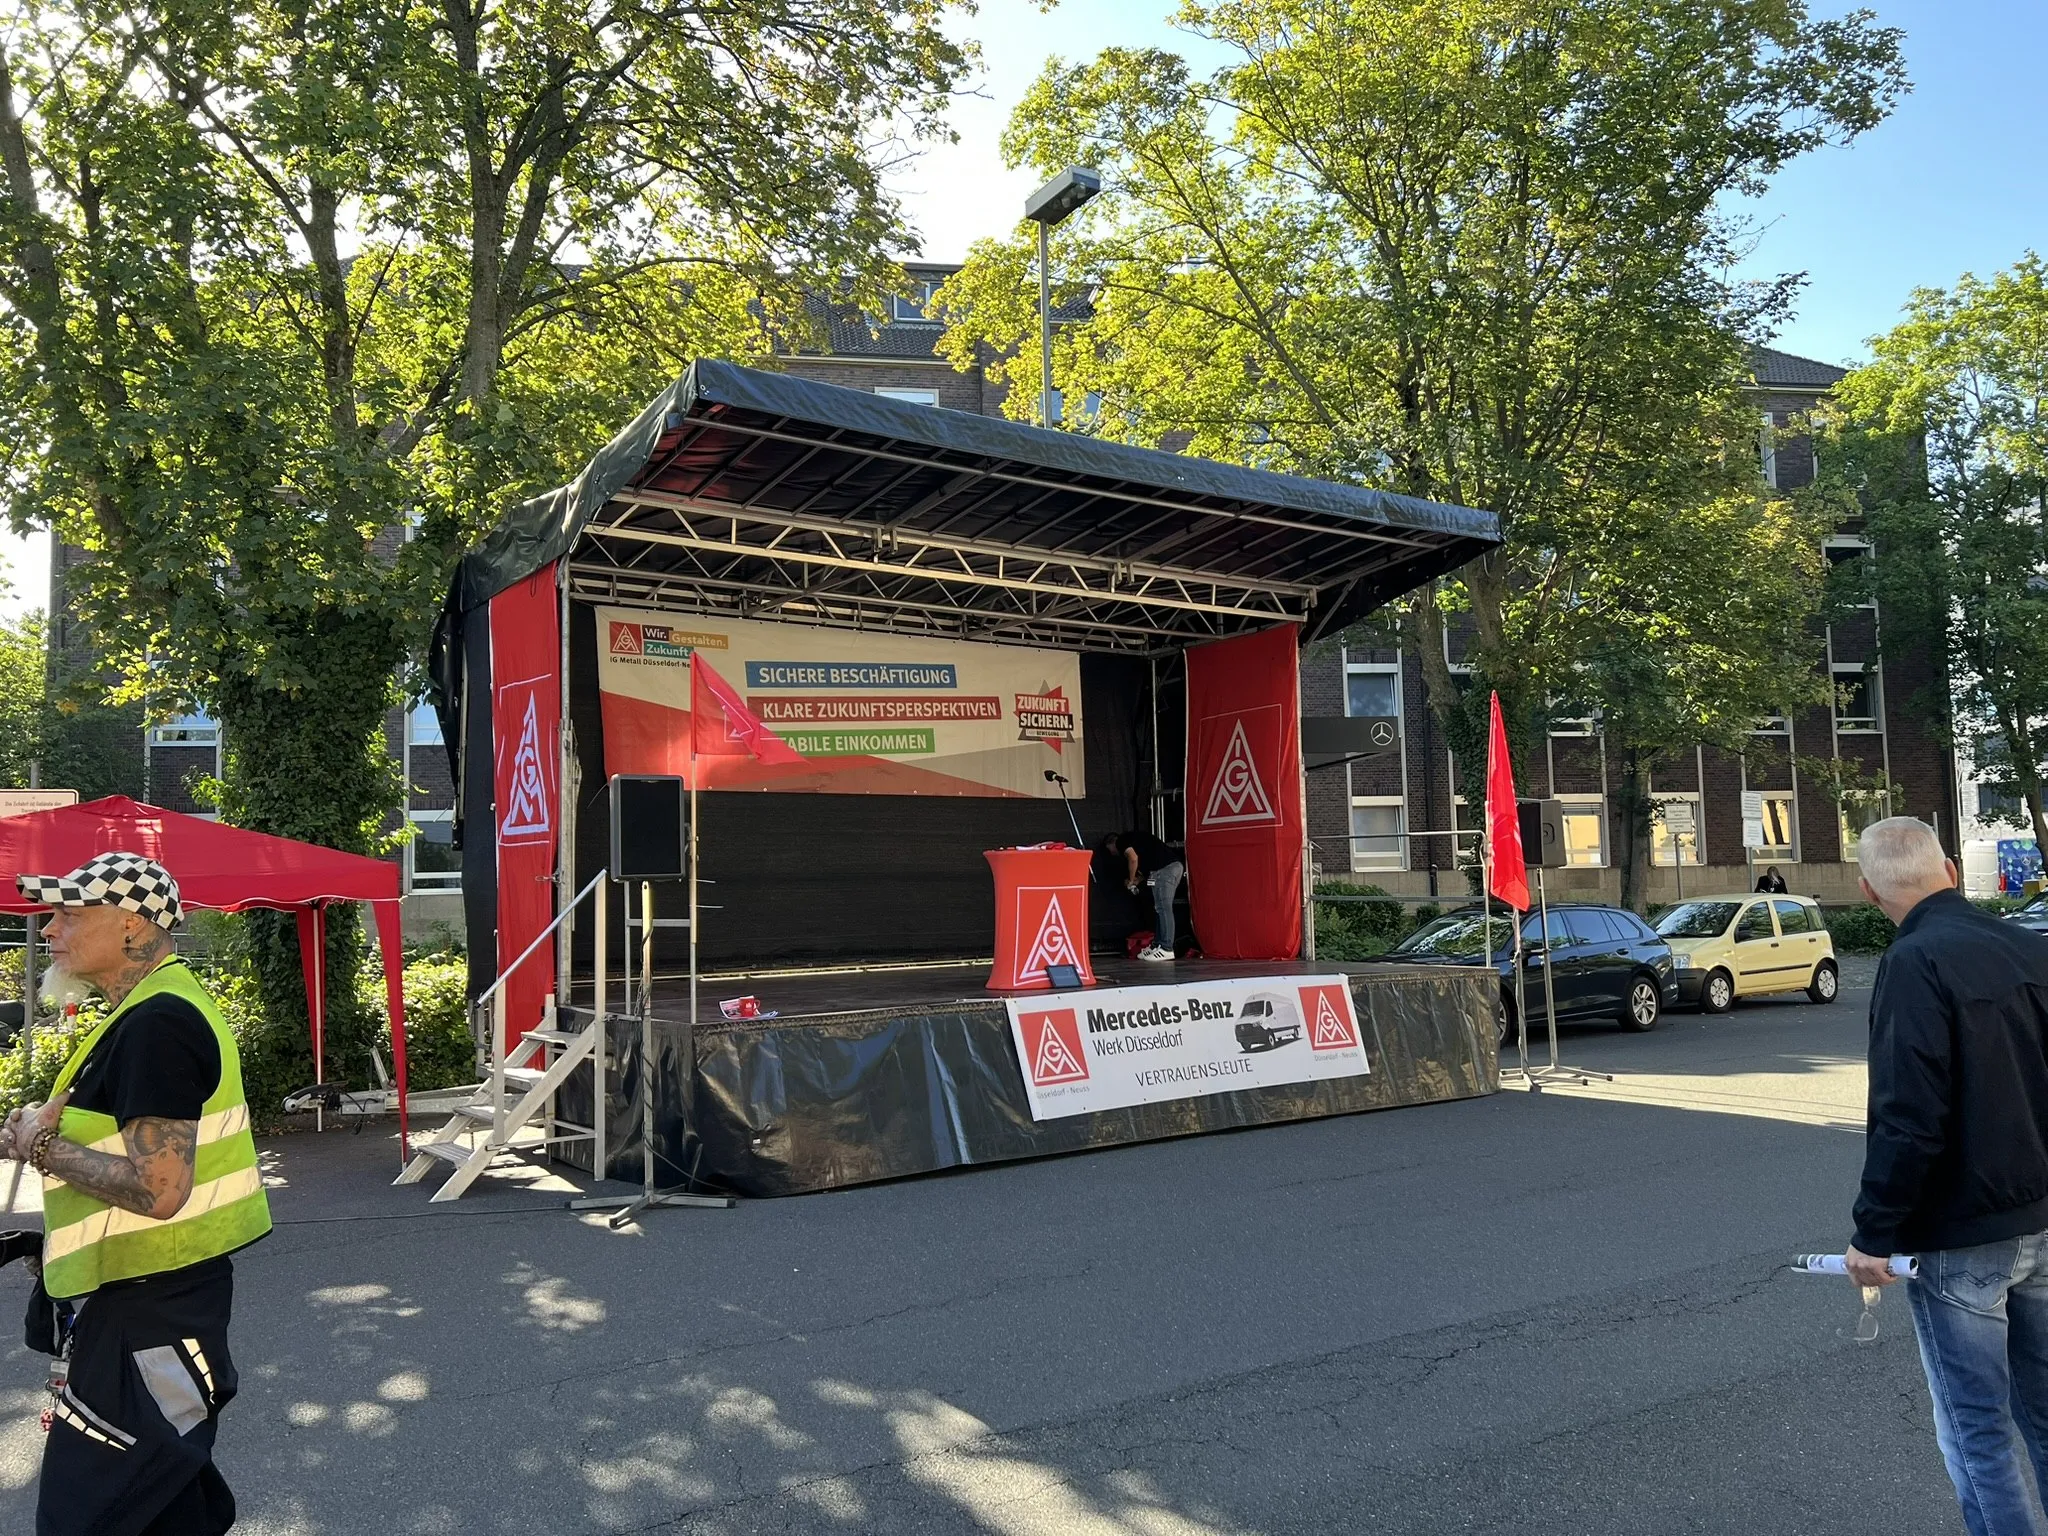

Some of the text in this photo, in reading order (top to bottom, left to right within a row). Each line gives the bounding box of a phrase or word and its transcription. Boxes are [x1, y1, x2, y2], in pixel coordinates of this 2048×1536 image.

[644, 627, 667, 639] Wir.
[671, 632, 726, 647] Gestalten.
[619, 657, 641, 665] Metall
[643, 658, 690, 668] Düsseldorf-Ne
[759, 665, 951, 684] SICHERE BESCHÄFTIGUNG
[762, 702, 997, 718] KLARE ZUKUNFTSPERSPEKTIVEN
[1017, 695, 1066, 712] ZUKUNFT
[1019, 712, 1073, 729] SICHERN.
[781, 734, 927, 752] ABILE EINKOMMEN
[1087, 998, 1234, 1033] Mercedes-Benz
[1092, 1029, 1184, 1056] Werk Düsseldorf
[1135, 1058, 1253, 1087] VERTRAUENSLEUTE
